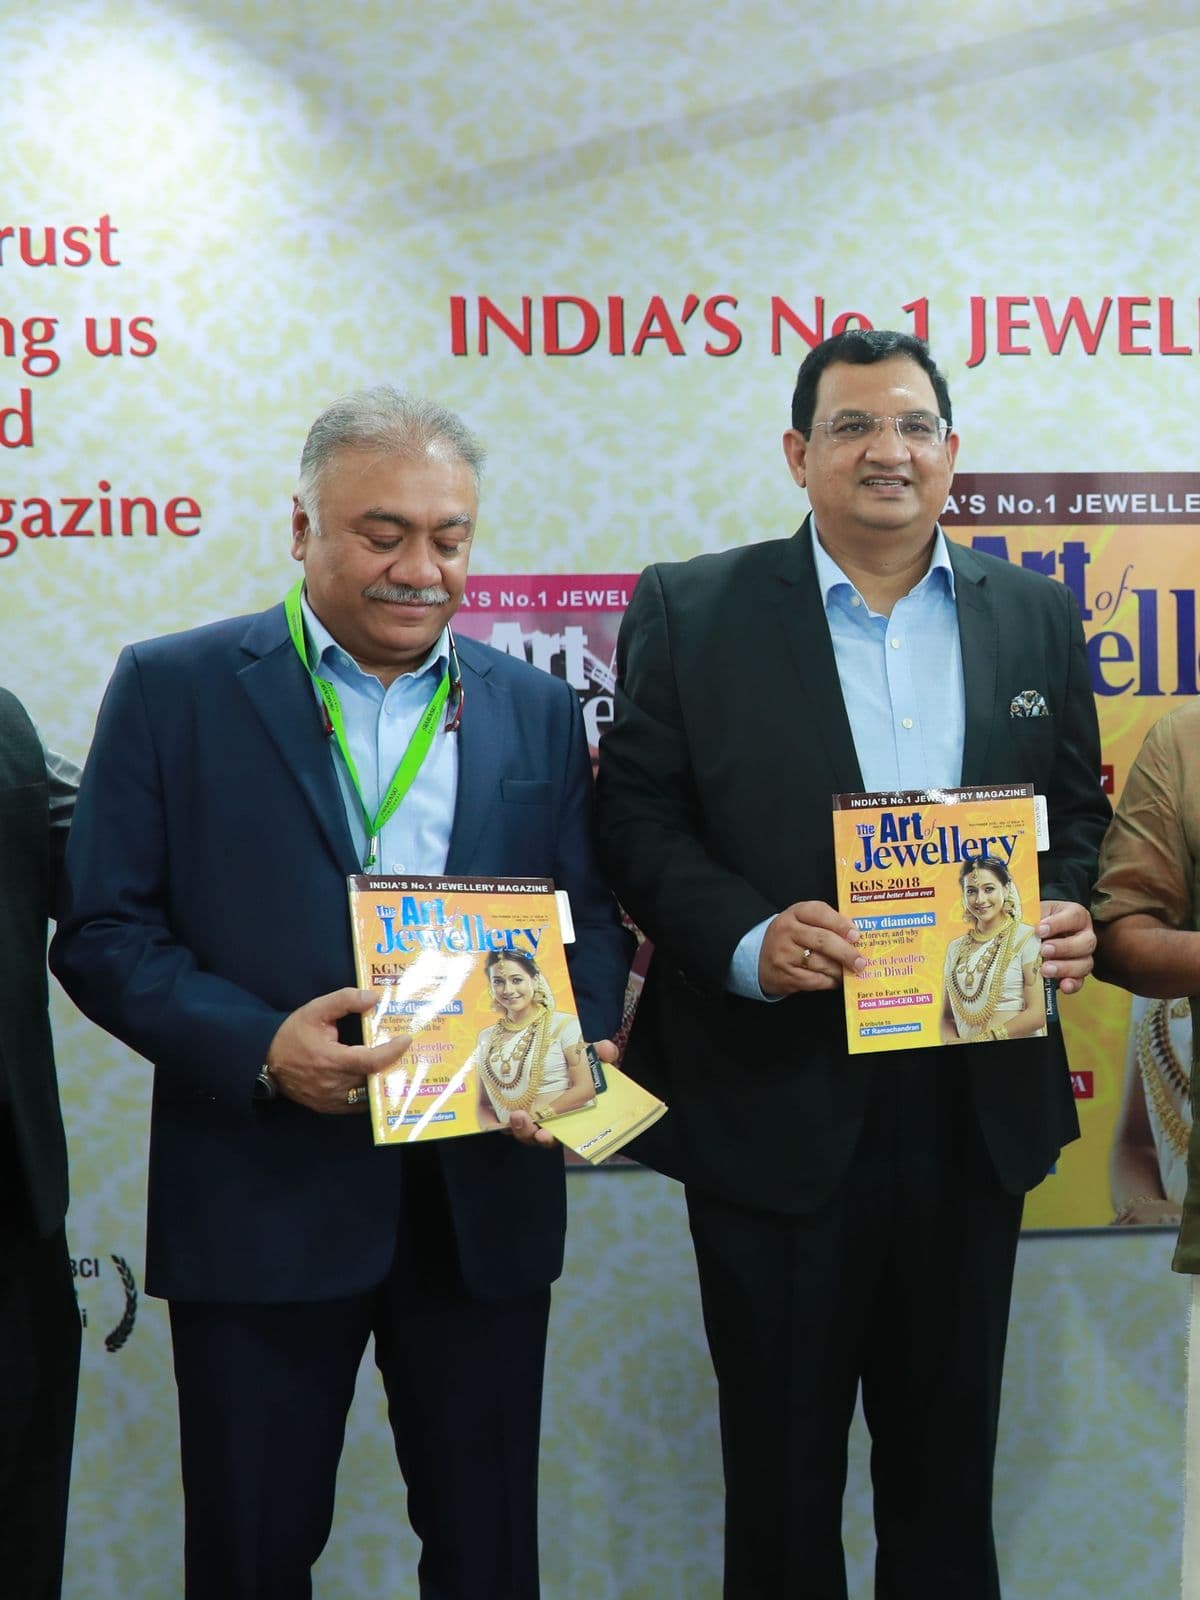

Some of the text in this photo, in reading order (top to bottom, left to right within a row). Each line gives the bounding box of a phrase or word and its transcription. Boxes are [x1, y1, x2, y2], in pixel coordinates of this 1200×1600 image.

[450, 294, 742, 357] INDIA'S
[85, 317, 158, 358] us
[997, 494, 1057, 515] No.1
[500, 591, 547, 608] No.1
[1094, 563, 1135, 625] of
[851, 797, 887, 807] INDIA'S
[890, 795, 911, 805] No.1
[975, 788, 1027, 799] MAGAZINE
[856, 822, 875, 835] The
[879, 812, 923, 843] Art
[854, 825, 1018, 873] Jewellery
[368, 880, 548, 893] INDIA'S No.1 JEWELLERY MAGAZINE
[850, 876, 920, 892] KGJS 2018
[853, 913, 933, 931] Why diamonds
[884, 964, 913, 977] Diwali
[857, 990, 874, 998] Face
[885, 987, 903, 996] Face
[903, 986, 919, 994] with
